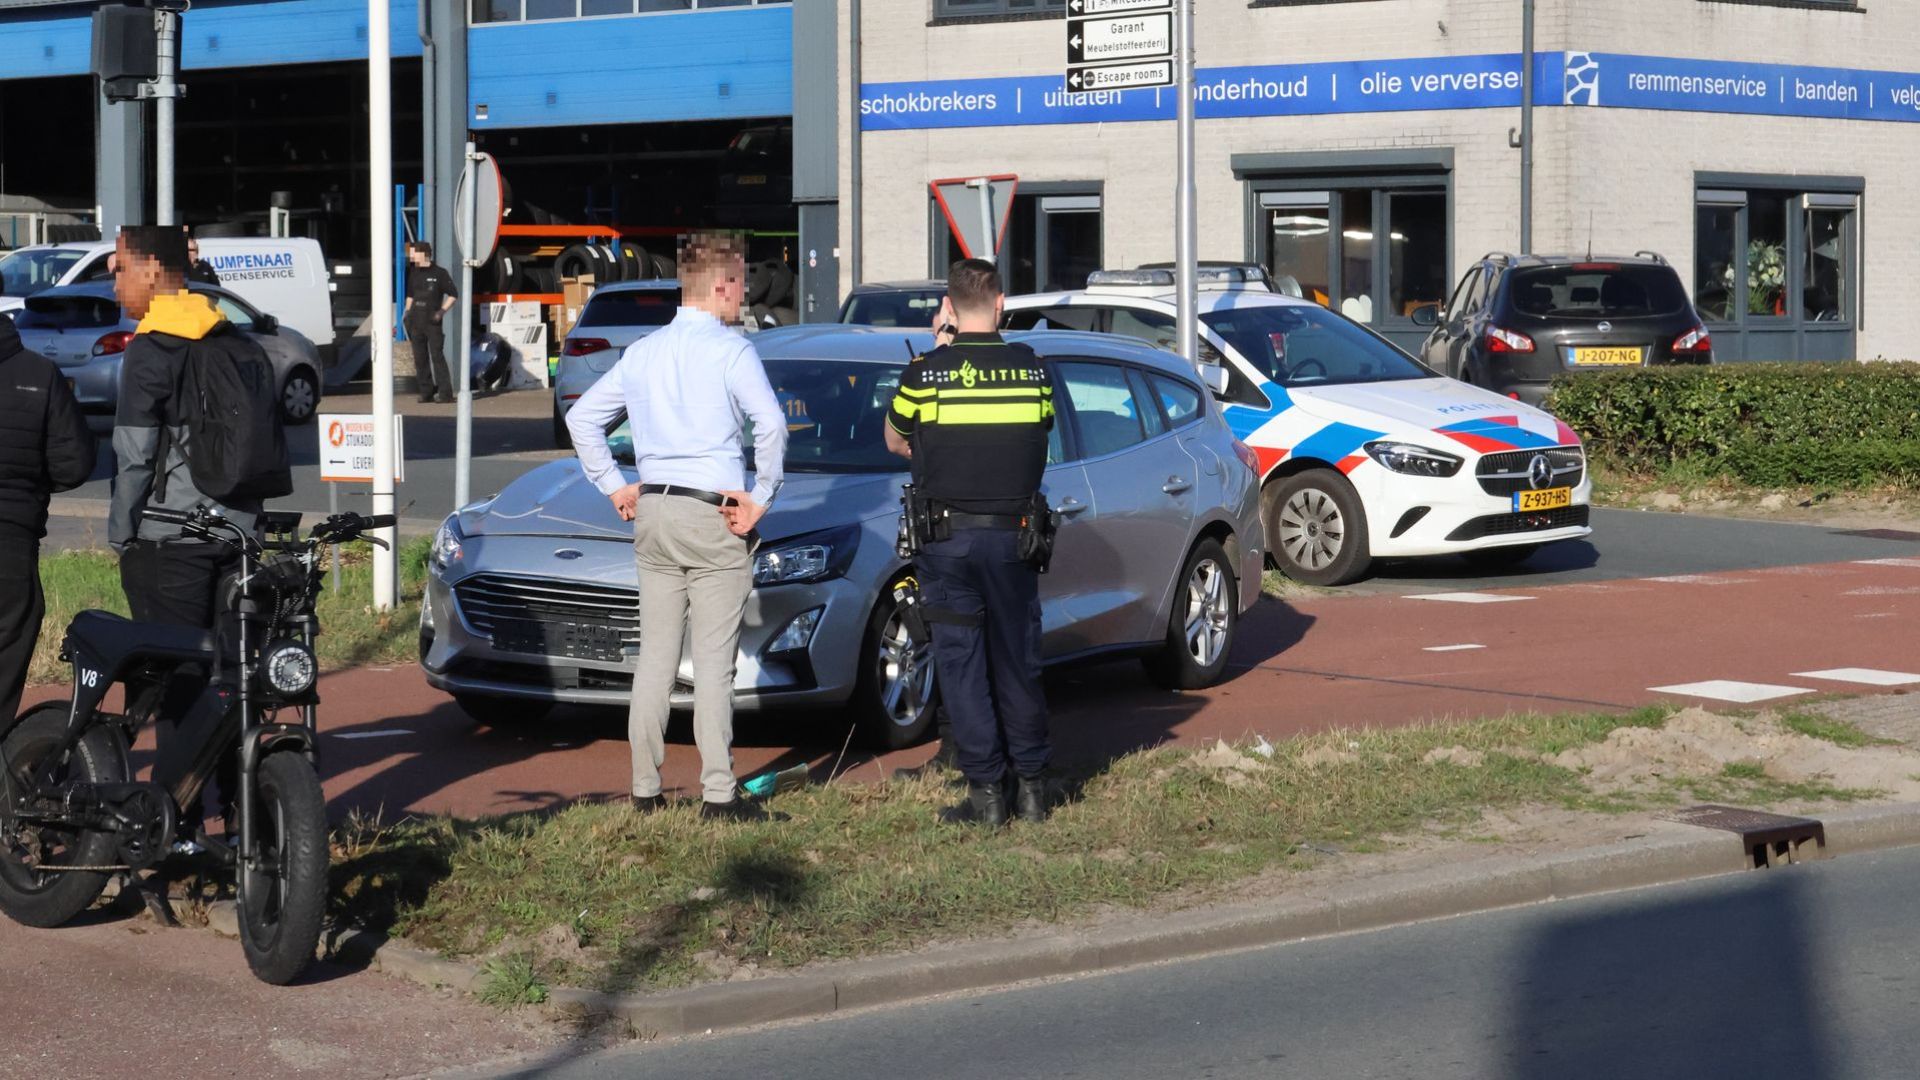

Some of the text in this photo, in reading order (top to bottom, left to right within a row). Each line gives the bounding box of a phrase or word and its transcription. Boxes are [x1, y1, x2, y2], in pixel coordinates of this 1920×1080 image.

[1111, 22, 1145, 34] Garant
[1087, 38, 1166, 53] Meubelstoffeerderij
[1097, 71, 1131, 83] Escape
[1134, 69, 1163, 80] rooms
[861, 90, 997, 114] schokbrekers
[1193, 76, 1308, 101] nderhoud
[1360, 72, 1402, 94] olie
[1628, 72, 1767, 97] remmenservice
[1795, 78, 1858, 102] banden
[206, 253, 293, 269] LUMPENAAR
[1579, 349, 1636, 361] J-207-NG
[353, 457, 374, 469] LEVER
[1523, 488, 1567, 508] Z-937-HS
[82, 667, 98, 687] V8
